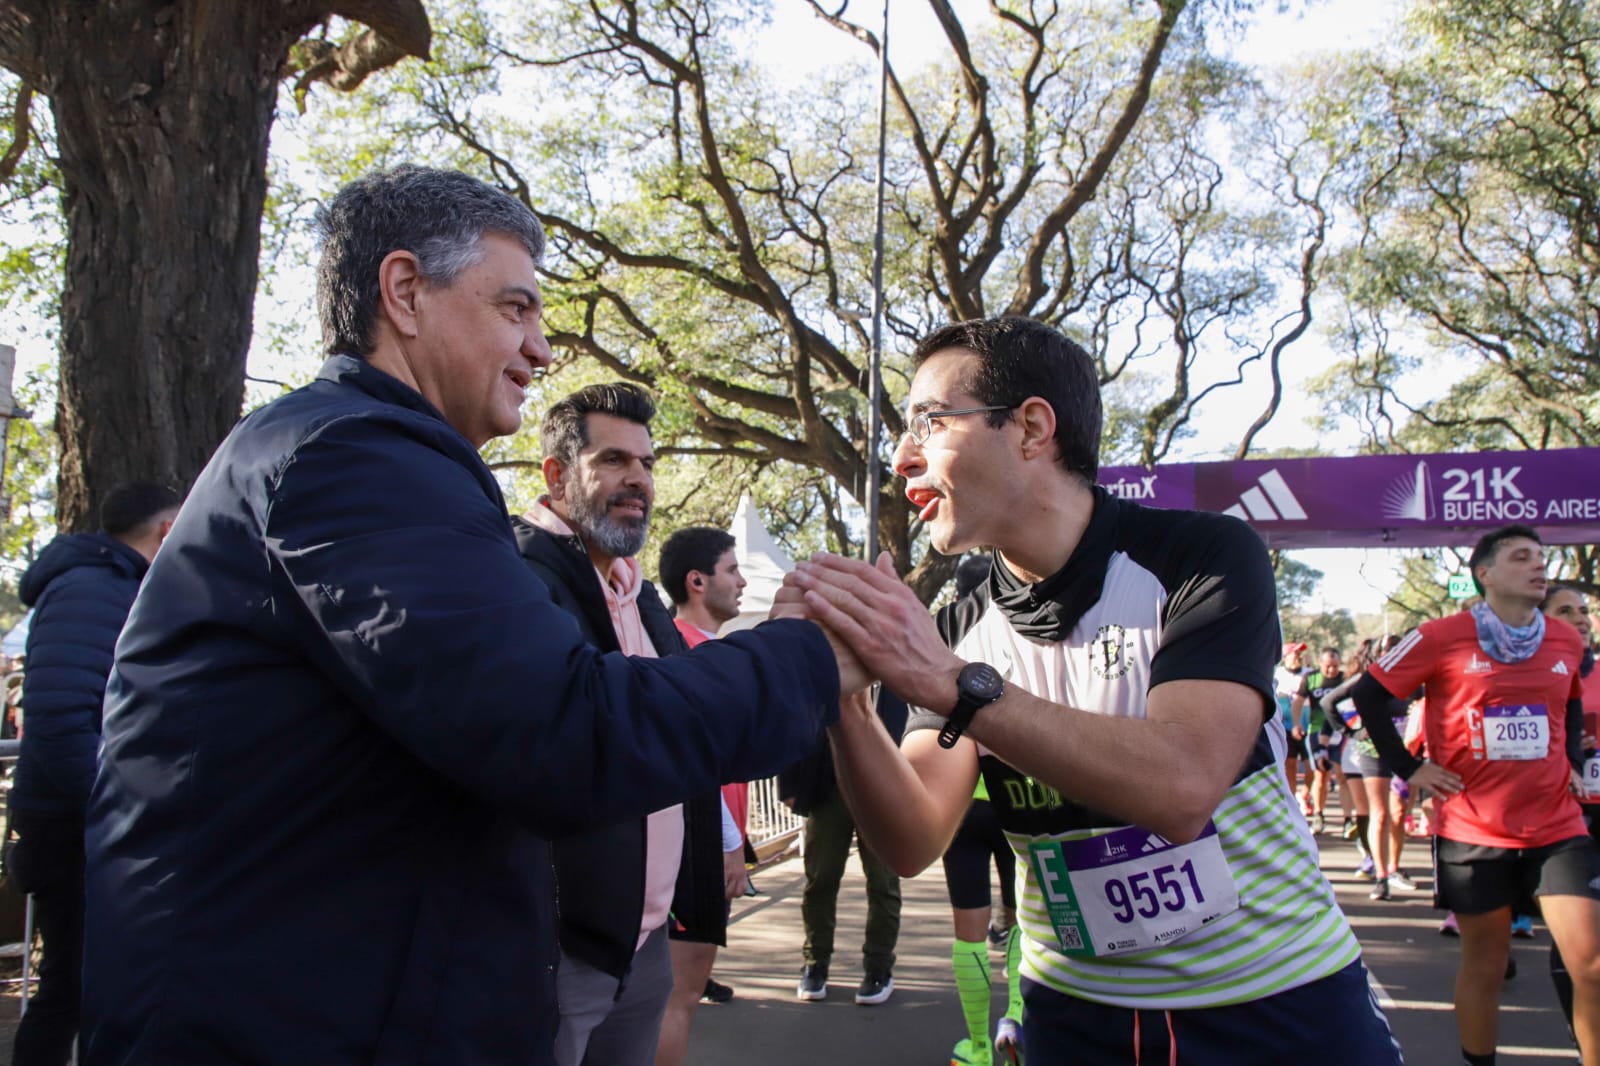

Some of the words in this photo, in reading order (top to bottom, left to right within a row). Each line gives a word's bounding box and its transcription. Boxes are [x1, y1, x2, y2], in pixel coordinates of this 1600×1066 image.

[1442, 466, 1524, 501] 21K
[1443, 500, 1538, 521] BUENOS
[1468, 709, 1481, 731] C
[1496, 721, 1539, 741] 2053
[1036, 850, 1068, 903] E
[1104, 859, 1205, 923] 9551
